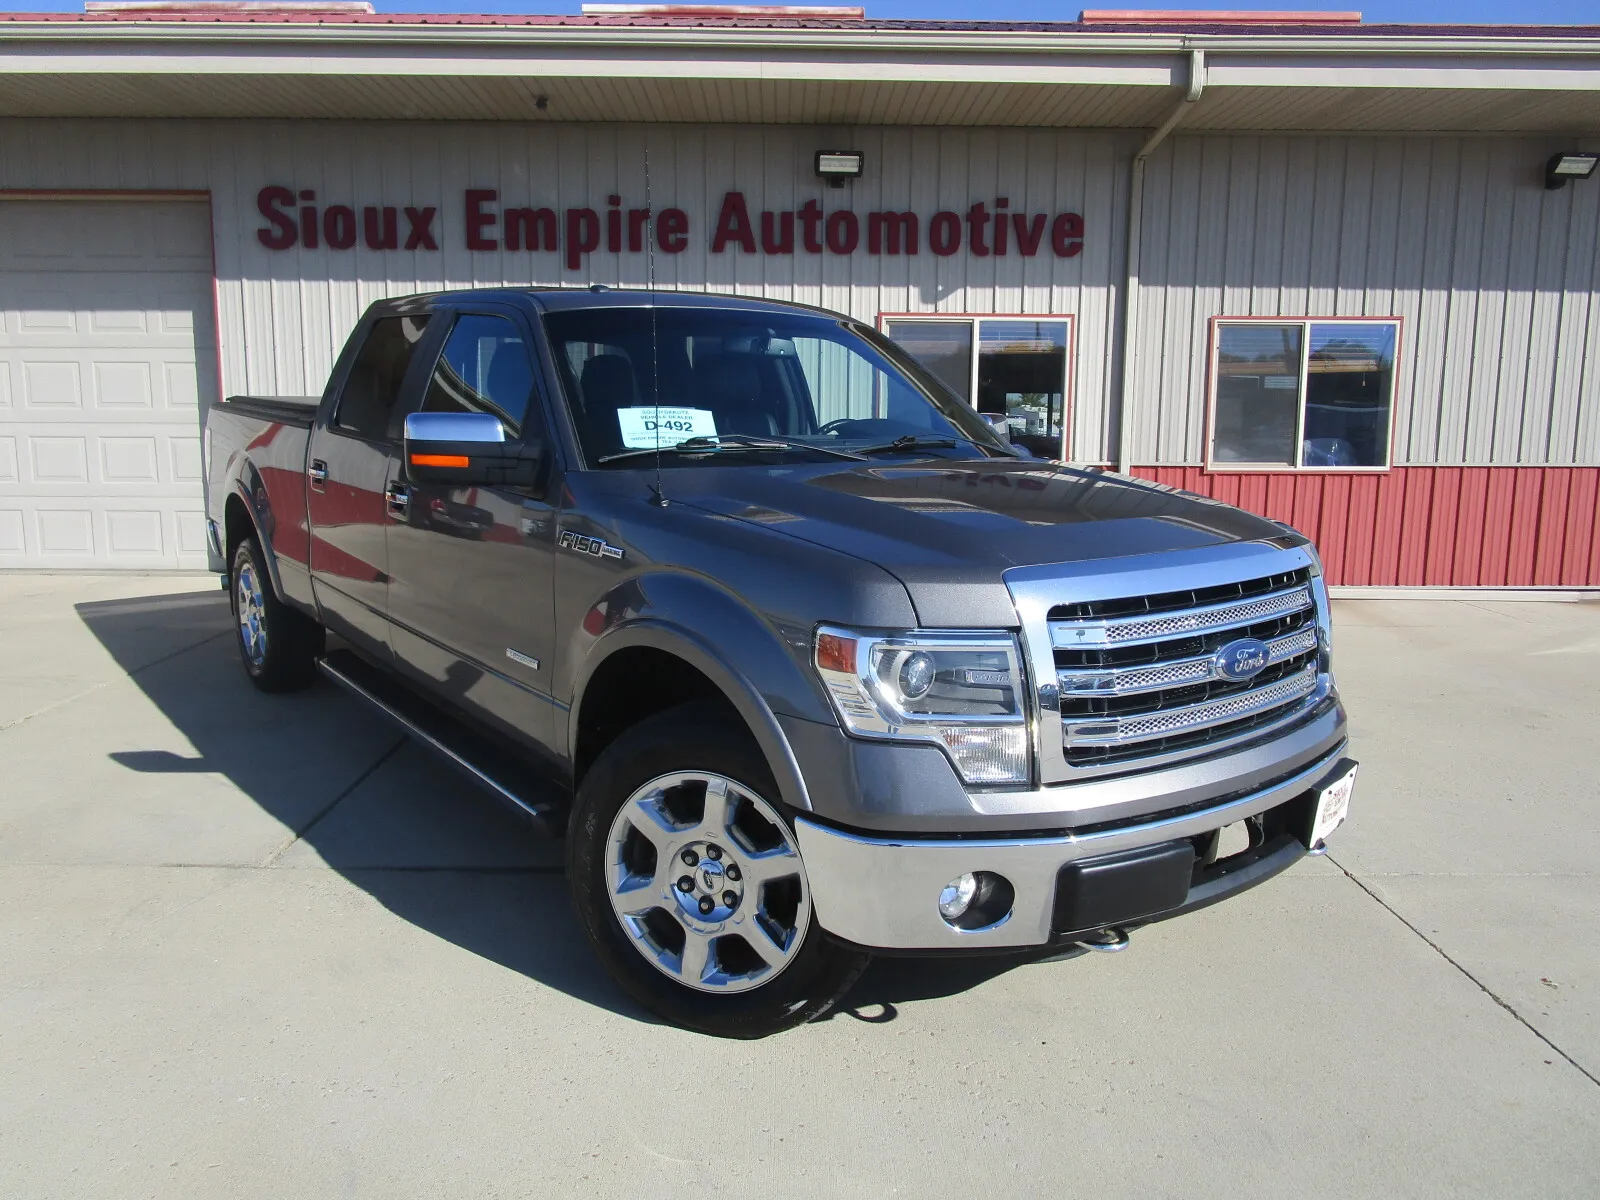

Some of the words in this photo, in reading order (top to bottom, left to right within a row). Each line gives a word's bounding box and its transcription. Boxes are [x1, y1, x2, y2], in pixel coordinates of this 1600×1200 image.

[256, 185, 439, 251] Sioux
[464, 189, 690, 270] Empire
[711, 191, 1085, 258] Automotive
[644, 420, 693, 432] D-492
[1234, 648, 1264, 673] Ford
